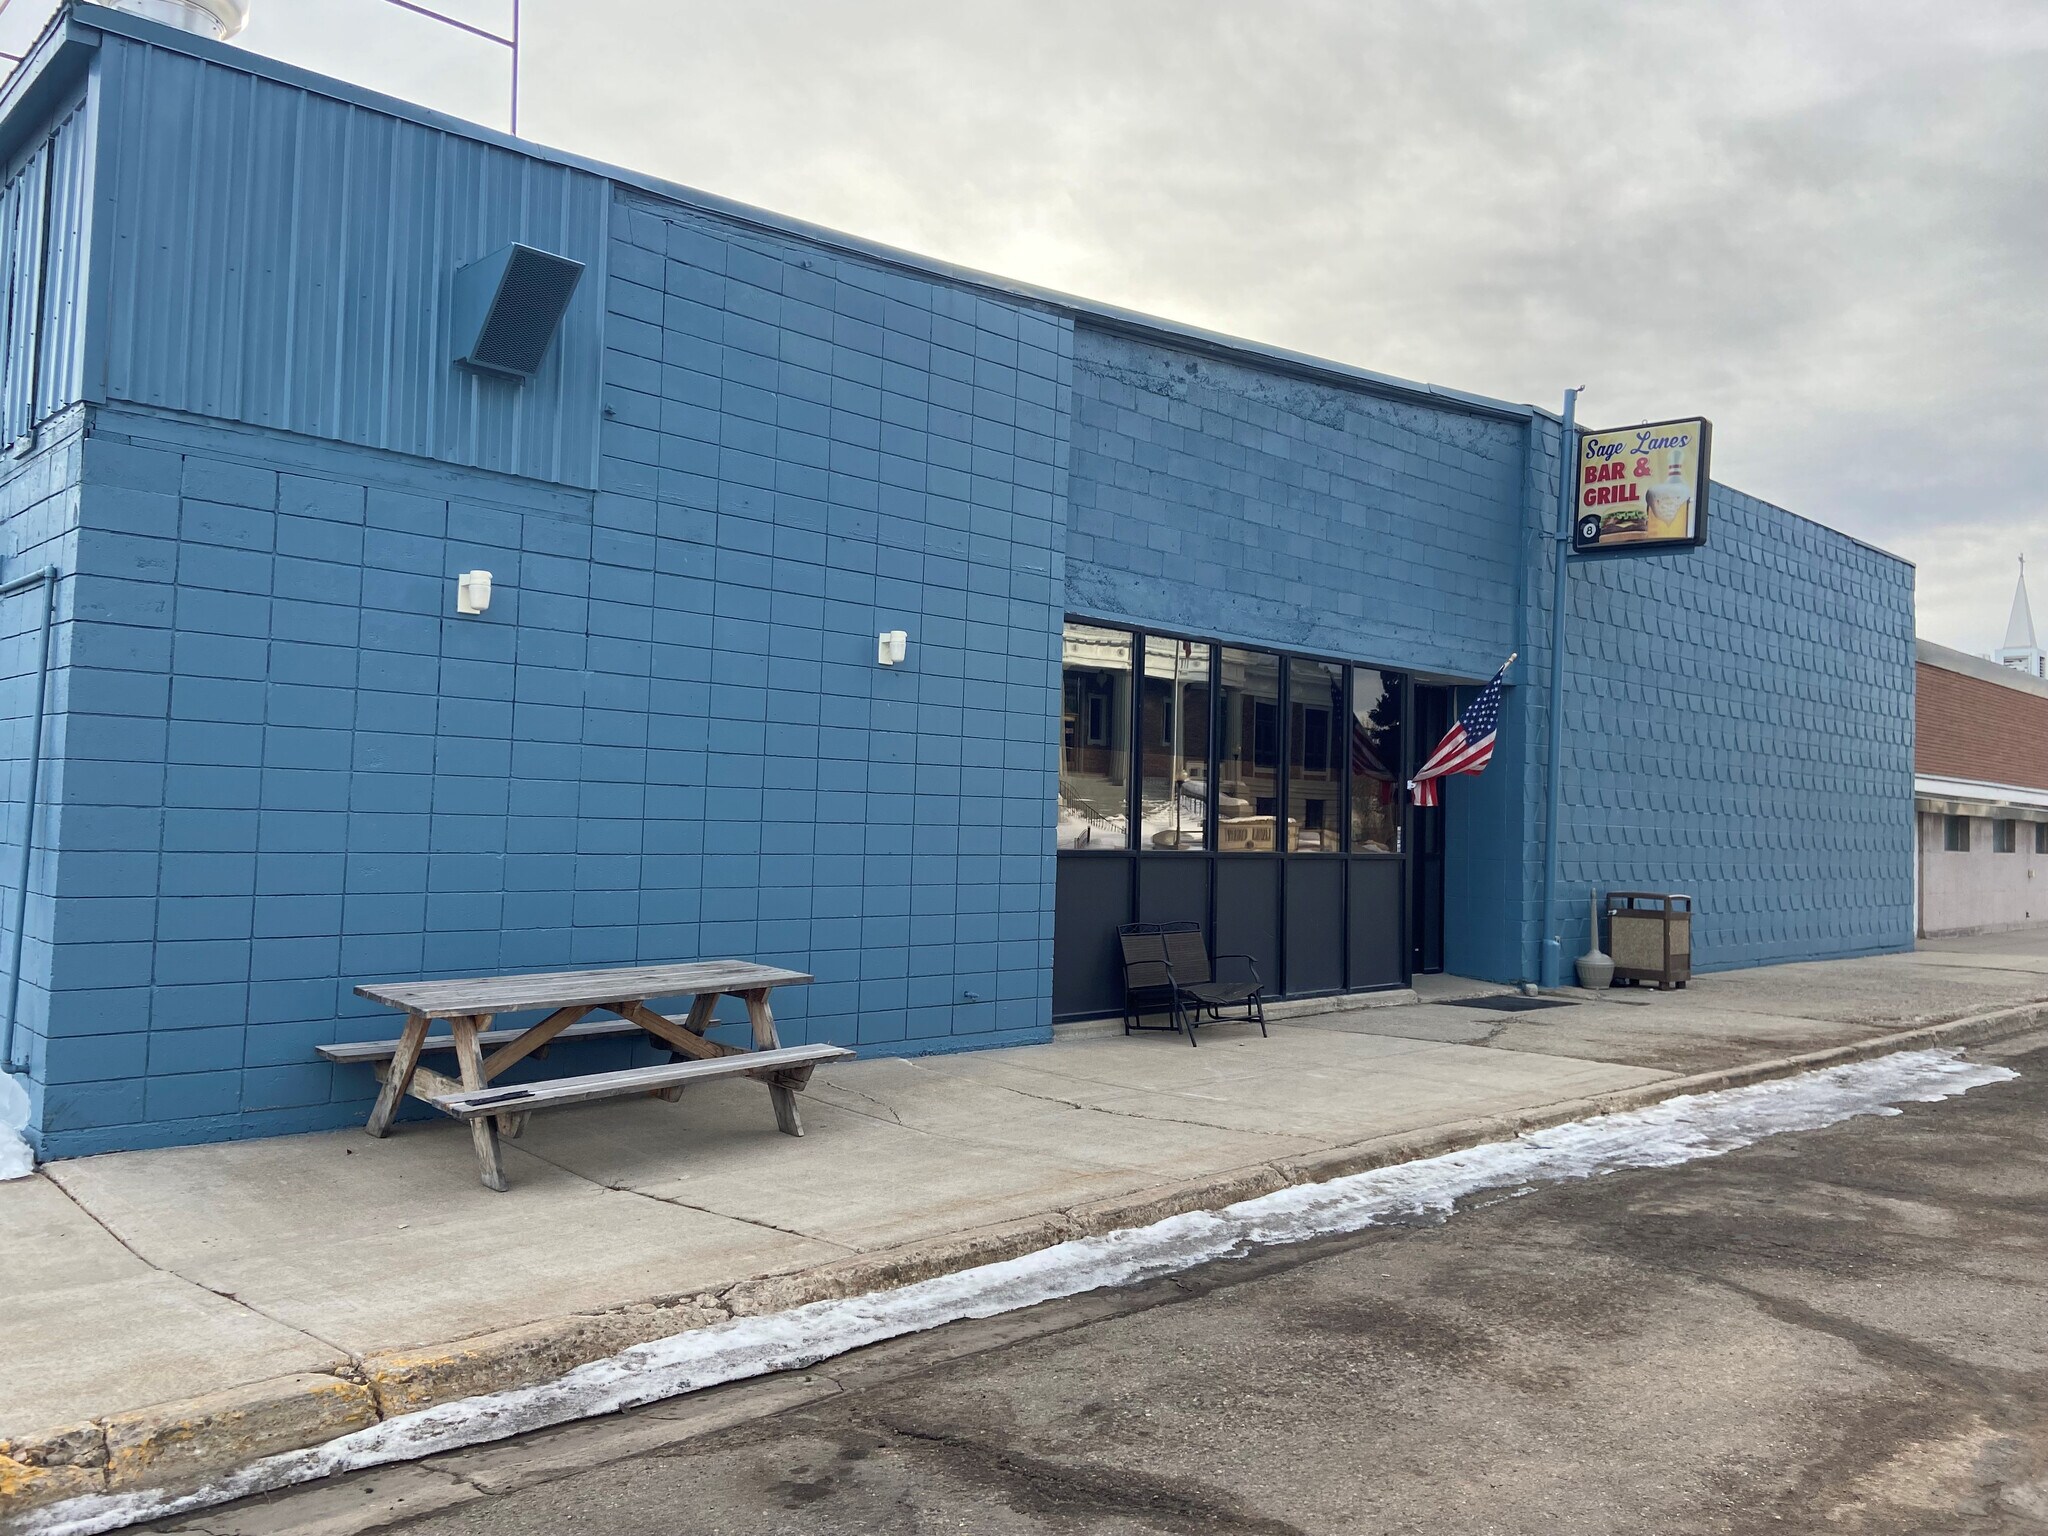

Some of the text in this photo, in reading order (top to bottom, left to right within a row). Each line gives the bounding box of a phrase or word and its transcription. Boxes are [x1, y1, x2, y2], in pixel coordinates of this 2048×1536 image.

[1585, 431, 1691, 461] Sage Lanes
[1584, 457, 1651, 484] BAR &
[1583, 483, 1640, 506] GRILL
